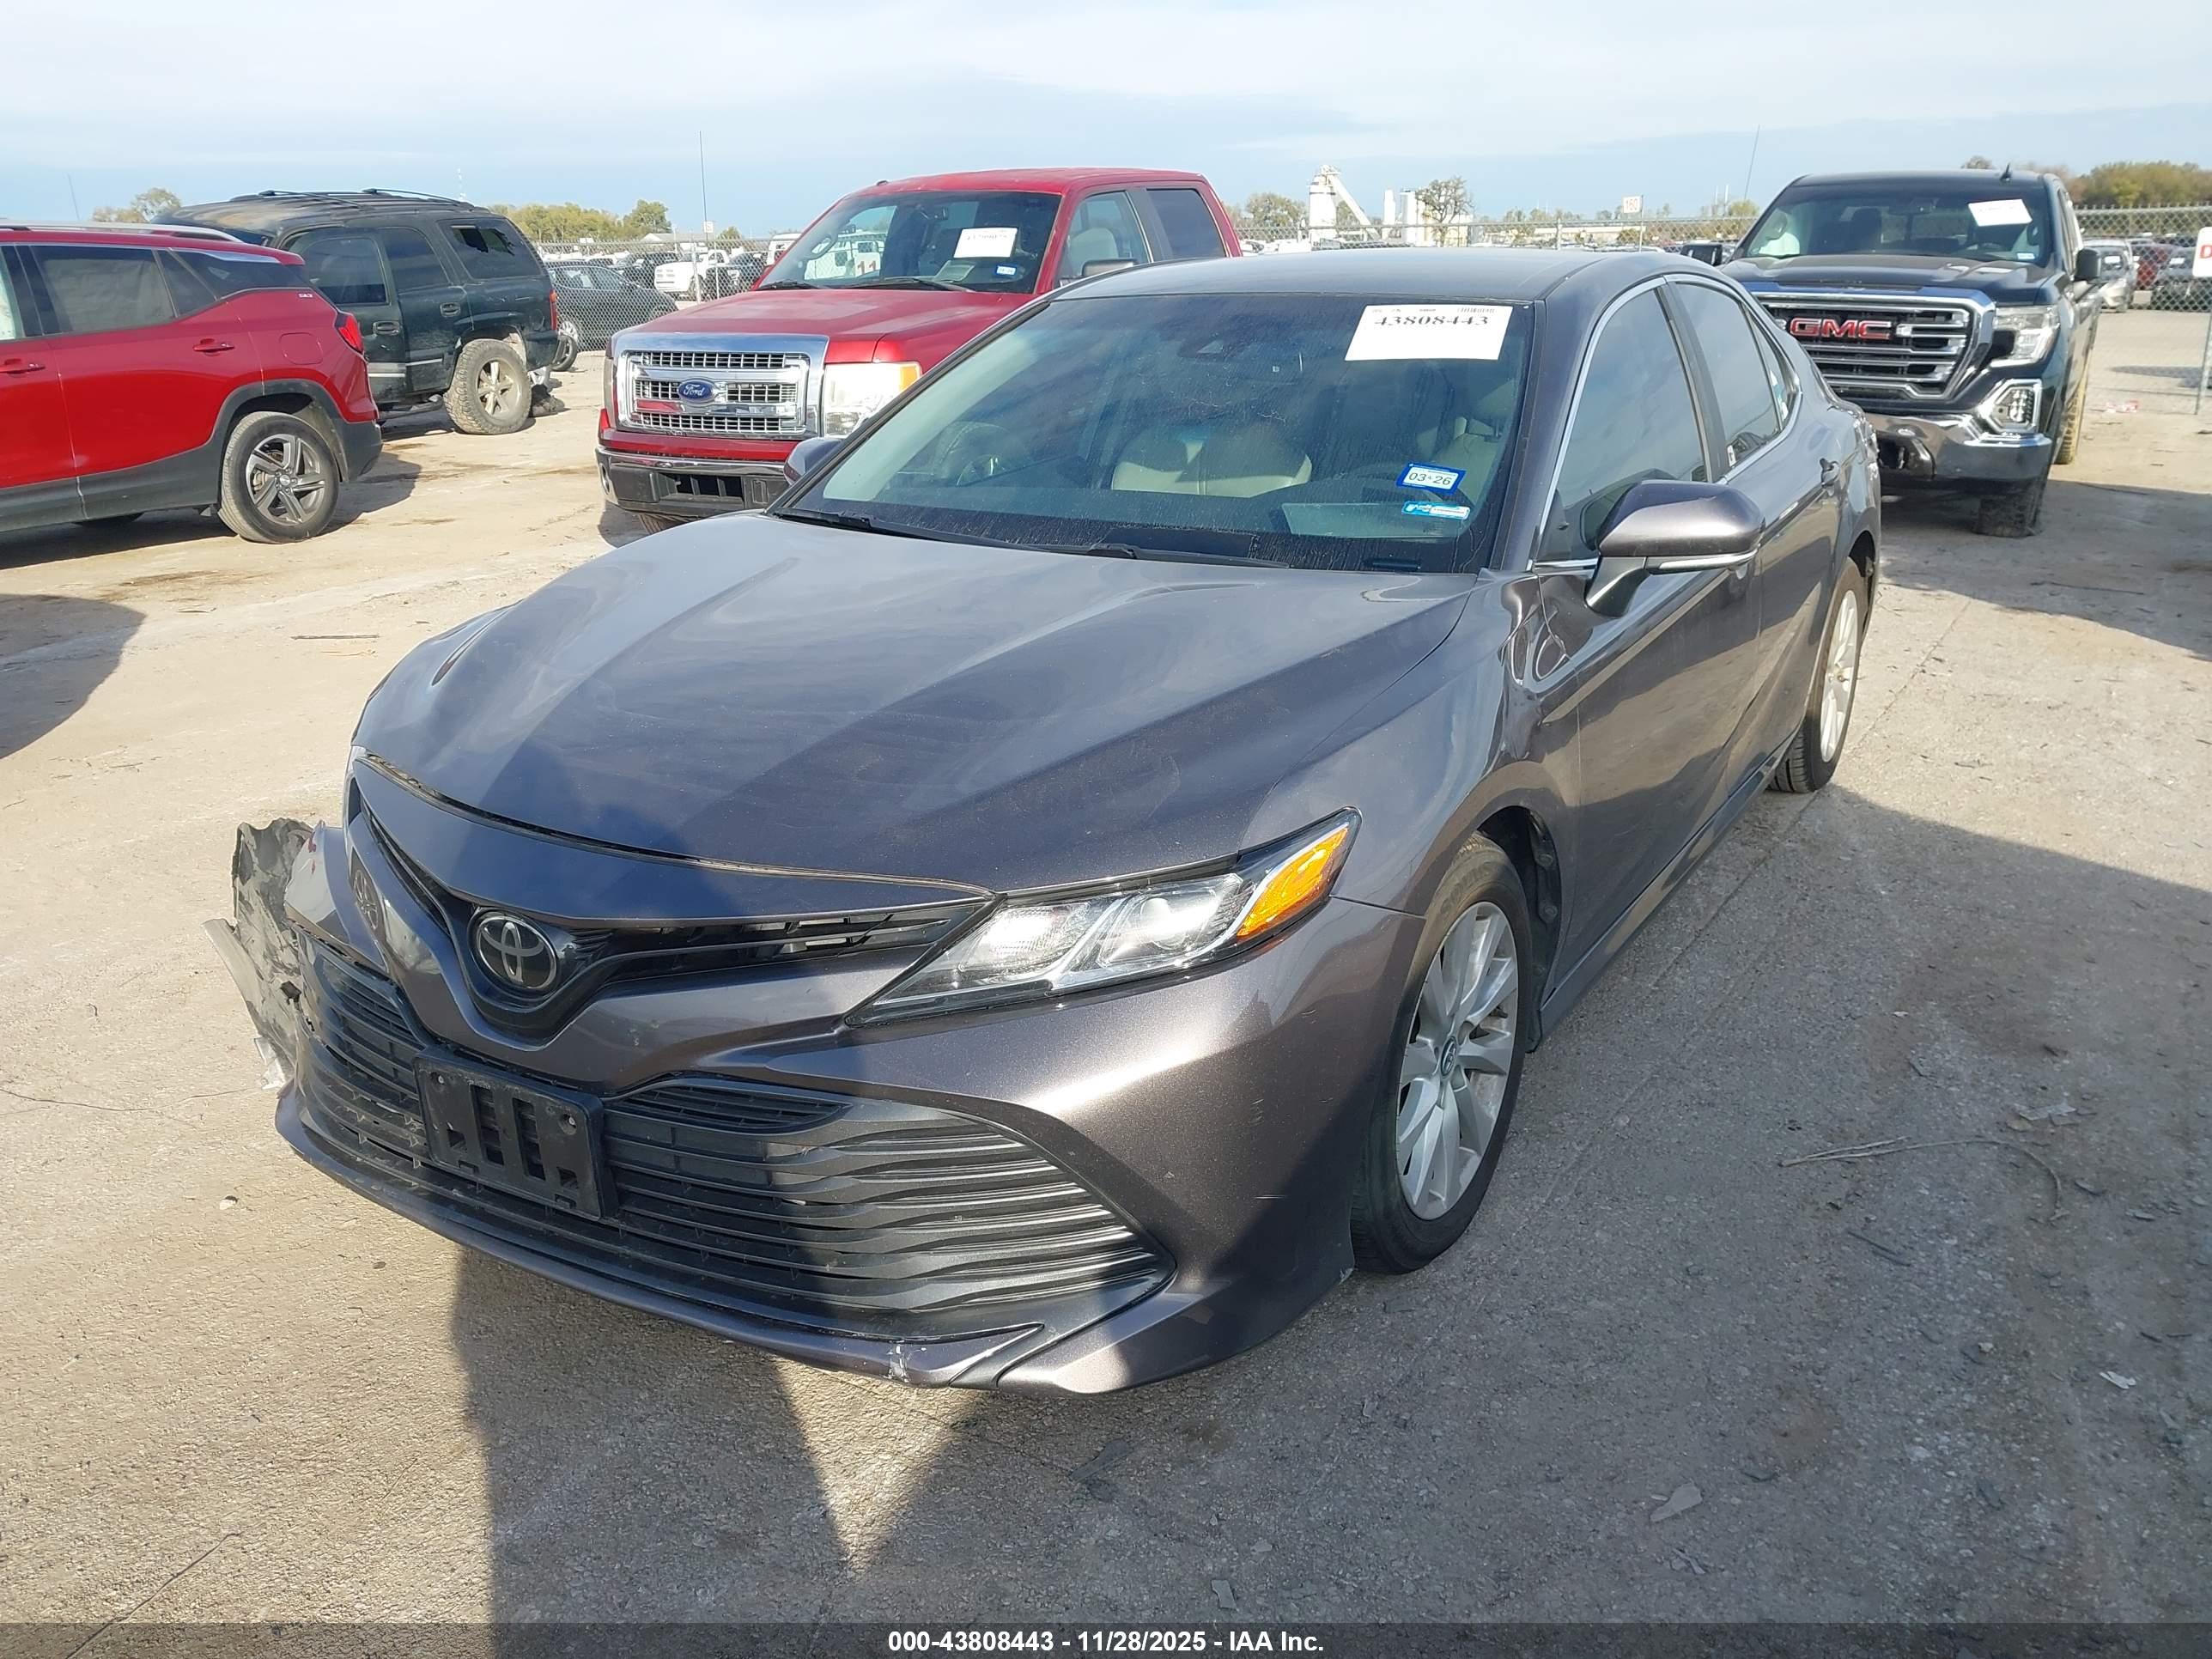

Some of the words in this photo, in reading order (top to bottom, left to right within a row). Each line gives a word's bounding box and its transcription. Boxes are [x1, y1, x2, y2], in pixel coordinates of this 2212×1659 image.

[1374, 315, 1489, 326] 43808443
[1789, 317, 1892, 339] GMC
[683, 383, 706, 397] Ford
[1408, 472, 1427, 482] 03
[1432, 476, 1452, 485] 26
